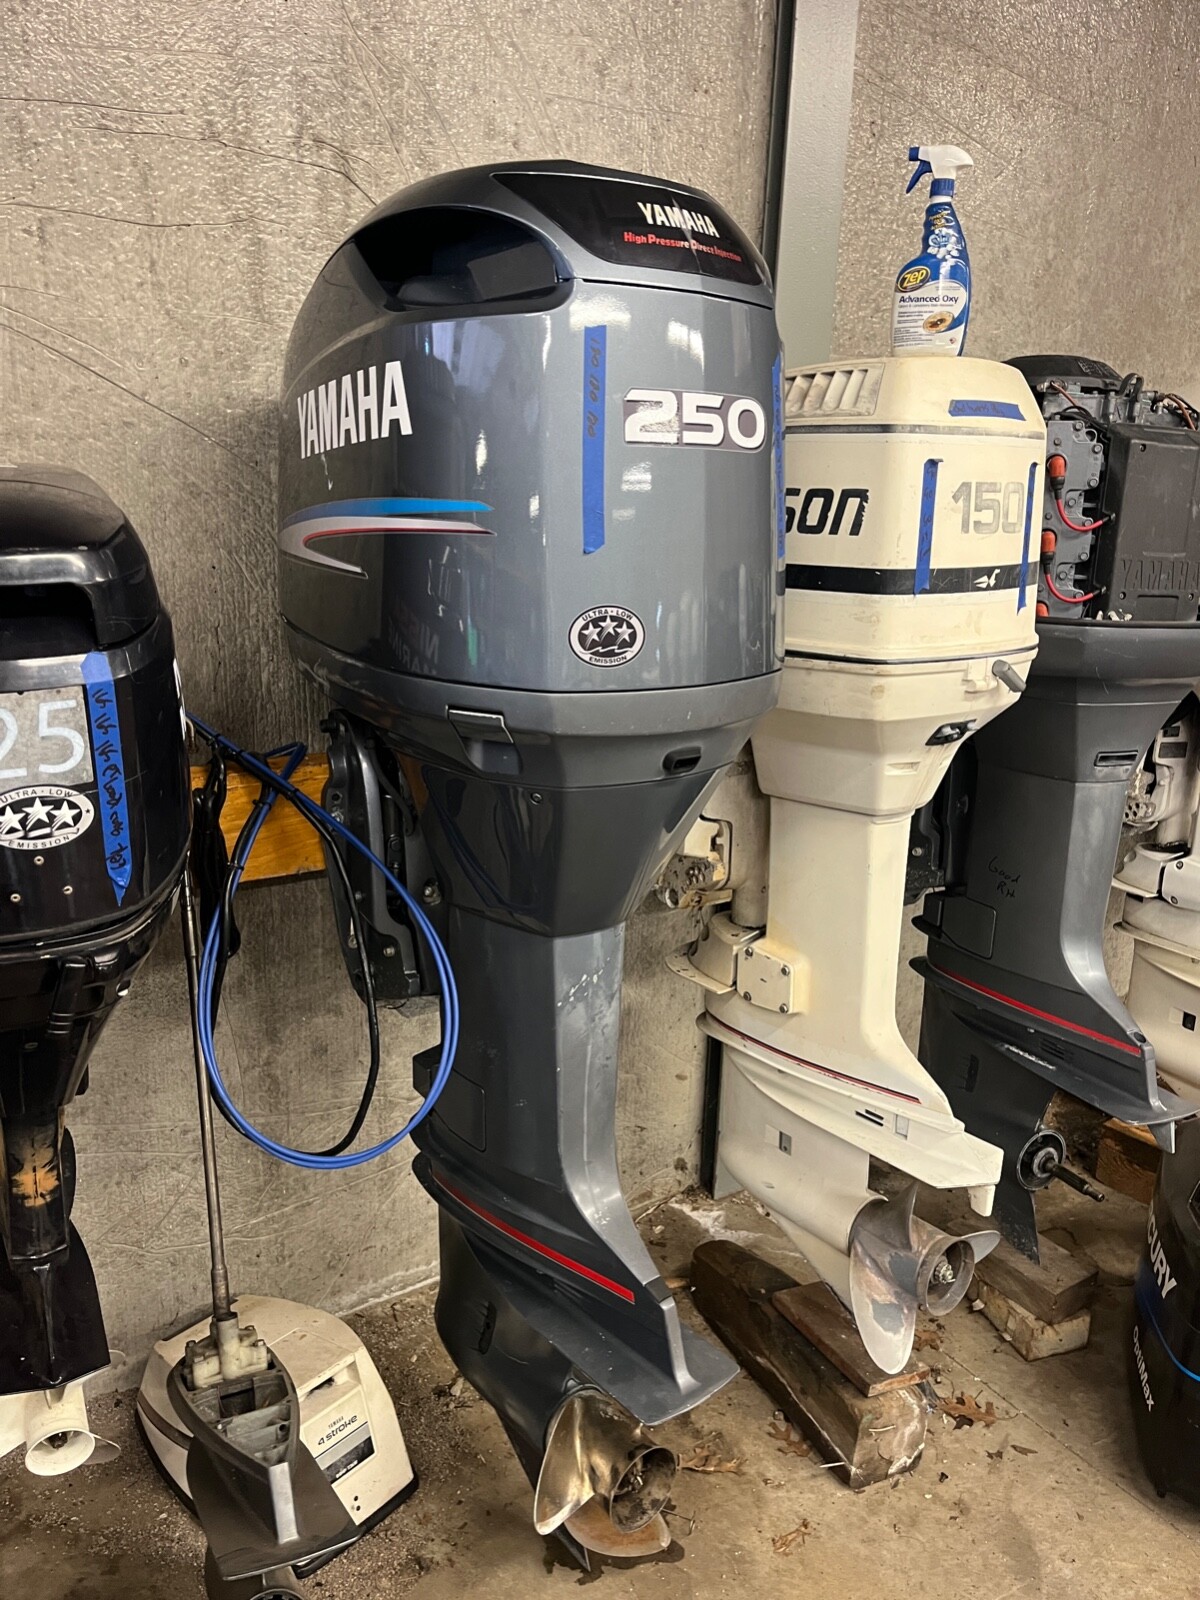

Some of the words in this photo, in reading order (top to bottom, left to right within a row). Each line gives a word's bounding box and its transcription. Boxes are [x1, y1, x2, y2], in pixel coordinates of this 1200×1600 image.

[637, 202, 720, 238] YAMAHA
[623, 232, 648, 244] High
[648, 233, 690, 249] Pressure
[690, 240, 714, 254] Direct
[899, 294, 940, 303] Advanced
[942, 294, 959, 305] Oxy
[297, 360, 413, 460] YAMAHA
[623, 388, 766, 449] 250
[951, 481, 1025, 535] 150
[1121, 558, 1200, 590] YAMAHA
[581, 609, 609, 622] ULTRA
[616, 609, 634, 621] LOW
[588, 655, 627, 665] EMISSION
[0, 788, 38, 804] ULTRA
[48, 788, 74, 798] LOW
[7, 835, 70, 850] EMISSION
[1147, 1207, 1178, 1299] CURY
